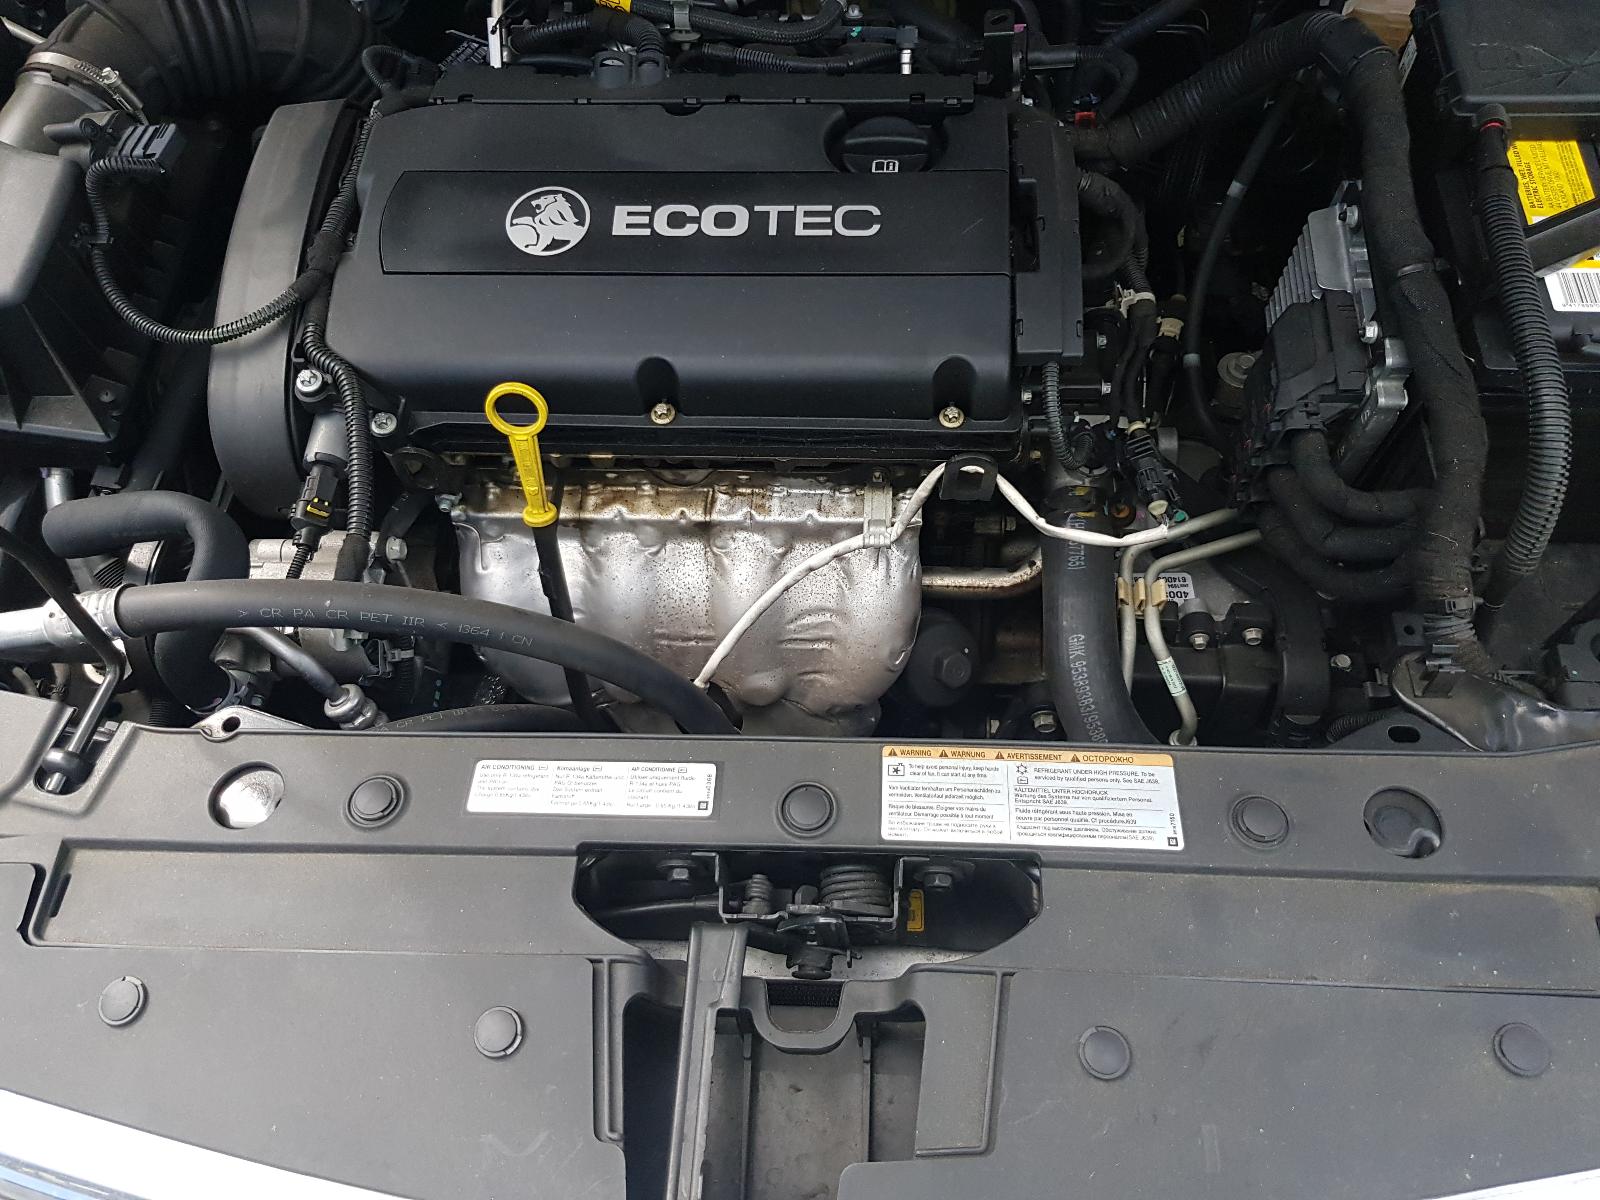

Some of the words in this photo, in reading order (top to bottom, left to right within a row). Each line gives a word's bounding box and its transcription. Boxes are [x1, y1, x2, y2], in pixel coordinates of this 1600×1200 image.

[1524, 162, 1536, 184] STORAGE
[1530, 185, 1544, 208] ELECTRIC
[612, 204, 882, 236] ECOTEC
[260, 608, 283, 618] CR
[293, 608, 315, 618] PA
[326, 609, 348, 620] CR
[360, 611, 393, 623] PET
[1082, 755, 1134, 763] ОСТОРОЖНО
